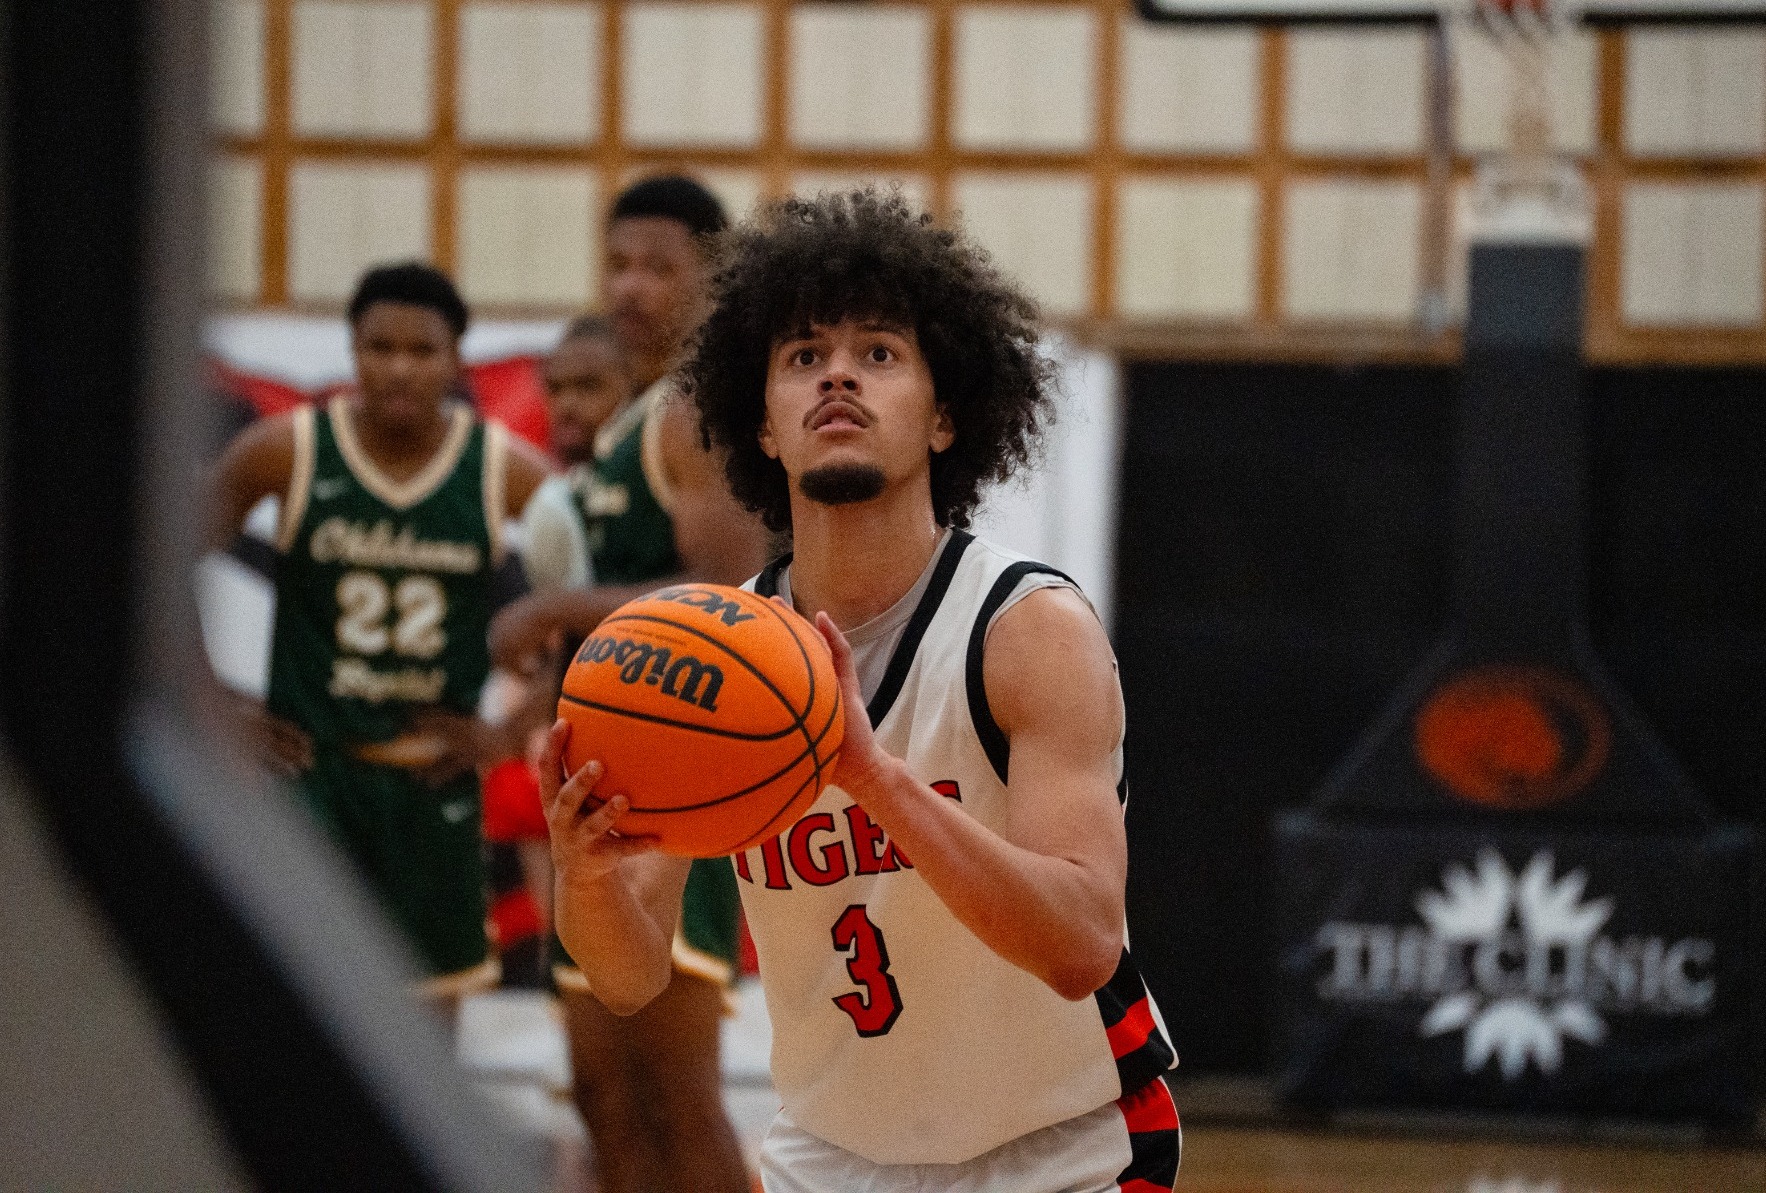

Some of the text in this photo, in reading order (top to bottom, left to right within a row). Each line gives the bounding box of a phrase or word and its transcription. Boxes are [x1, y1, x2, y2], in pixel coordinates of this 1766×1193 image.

[334, 571, 449, 658] 22
[576, 637, 725, 713] Wilson
[831, 904, 904, 1038] 3
